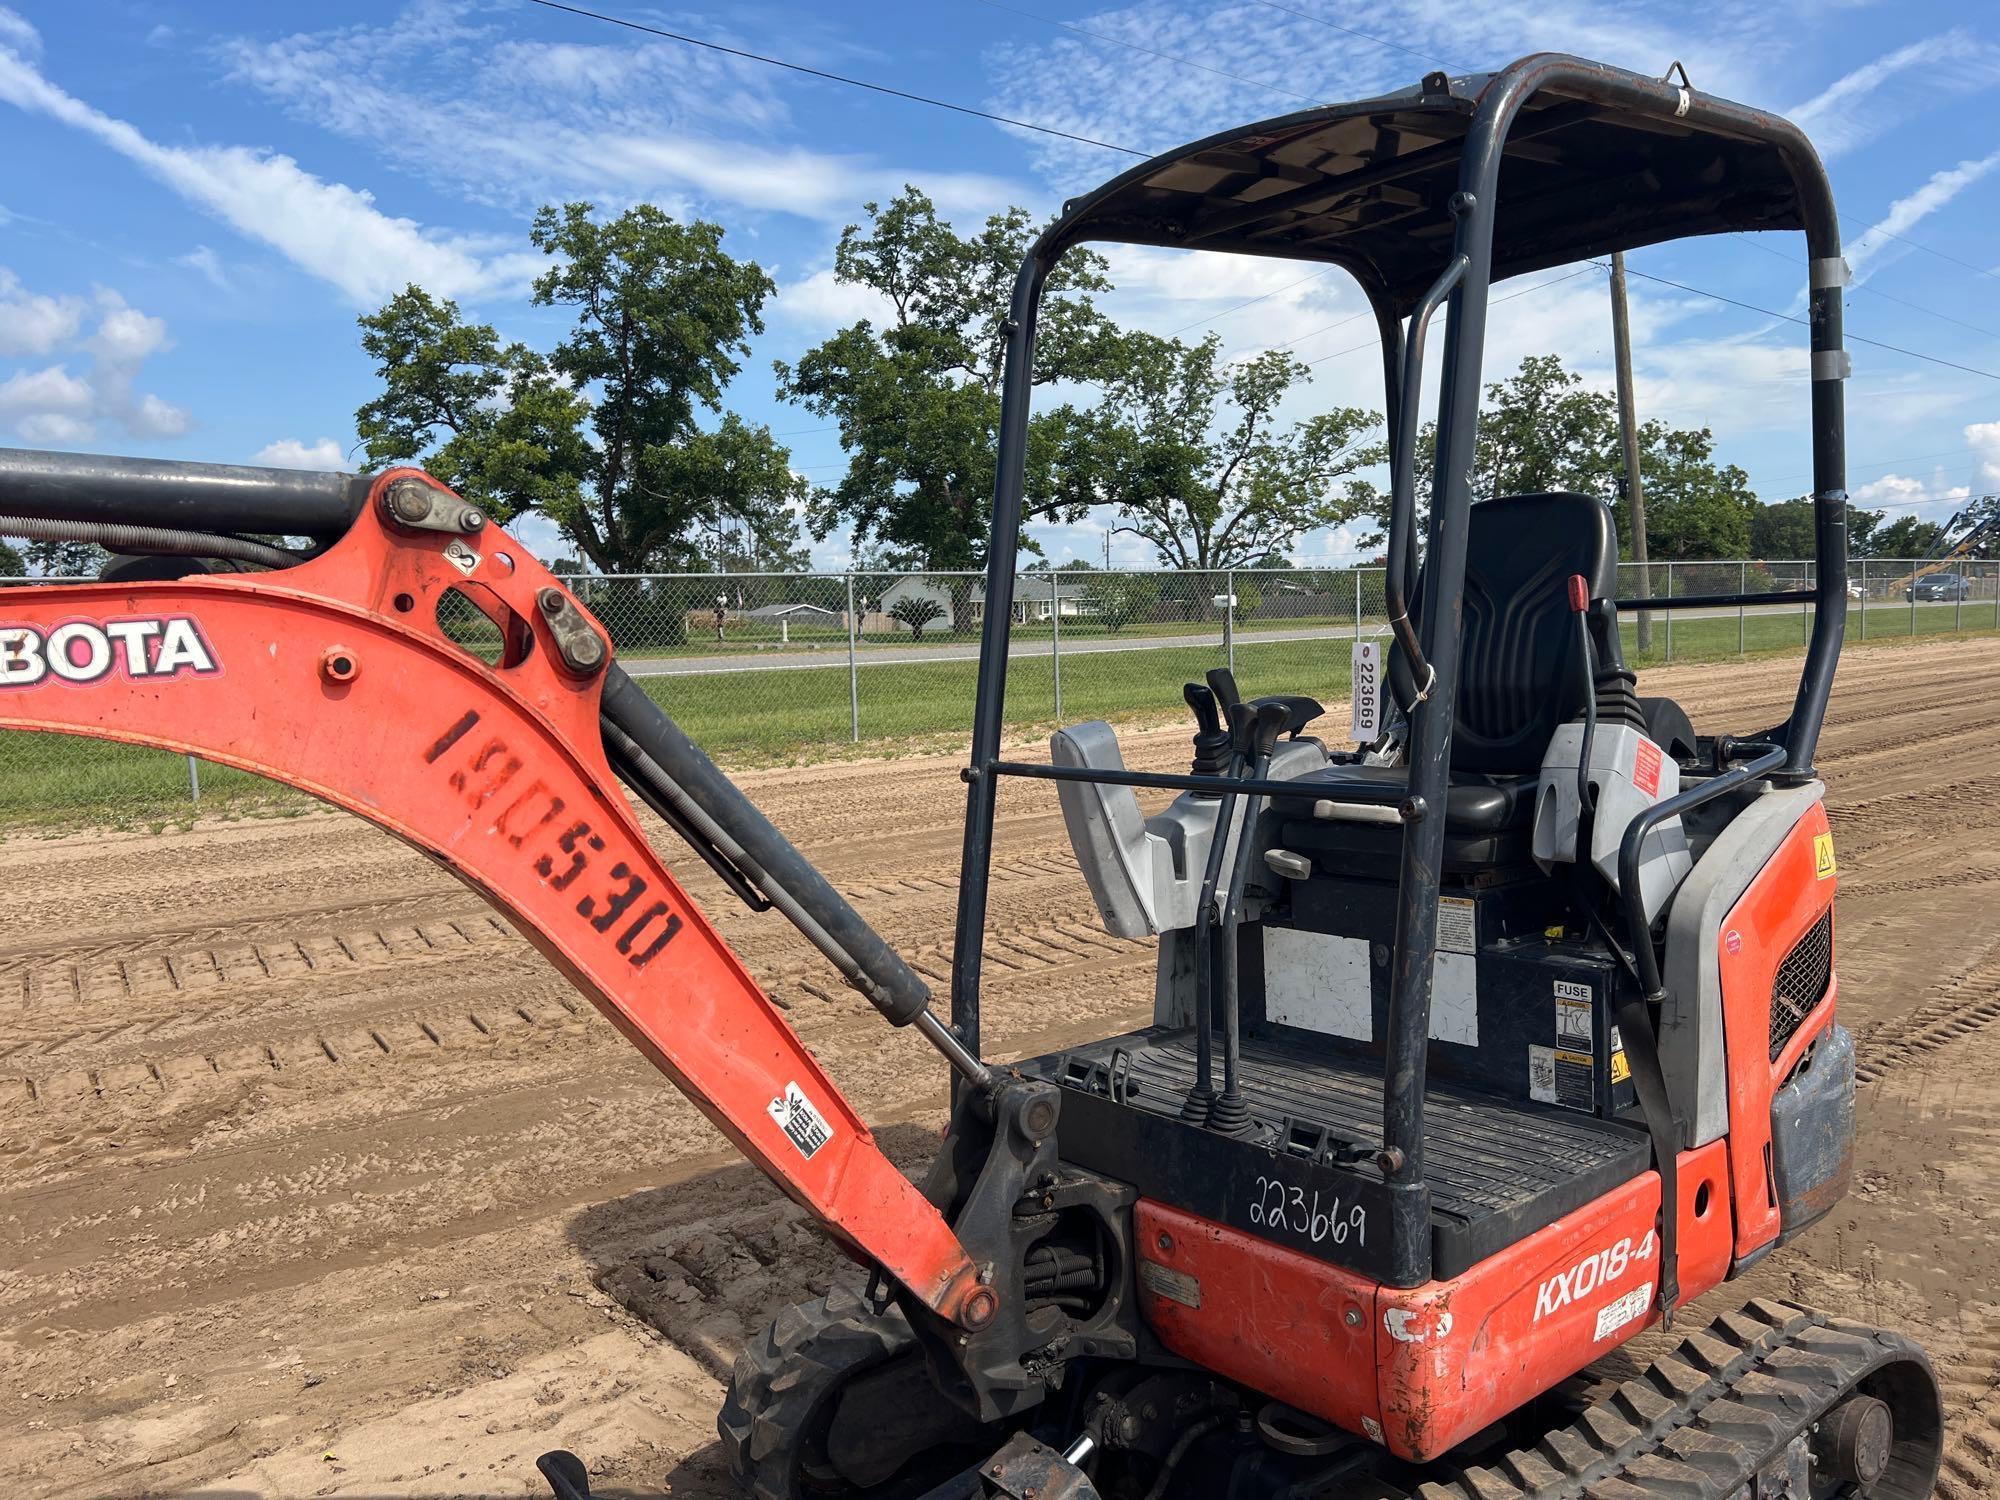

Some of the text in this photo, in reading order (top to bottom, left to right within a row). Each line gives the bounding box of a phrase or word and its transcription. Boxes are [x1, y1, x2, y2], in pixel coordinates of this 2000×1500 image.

[0, 618, 215, 685] BOTA
[1360, 663, 1374, 729] 223669
[1557, 984, 1588, 998] FUSE
[1249, 1176, 1366, 1248] 223669
[1533, 1228, 1656, 1323] KX018-4
